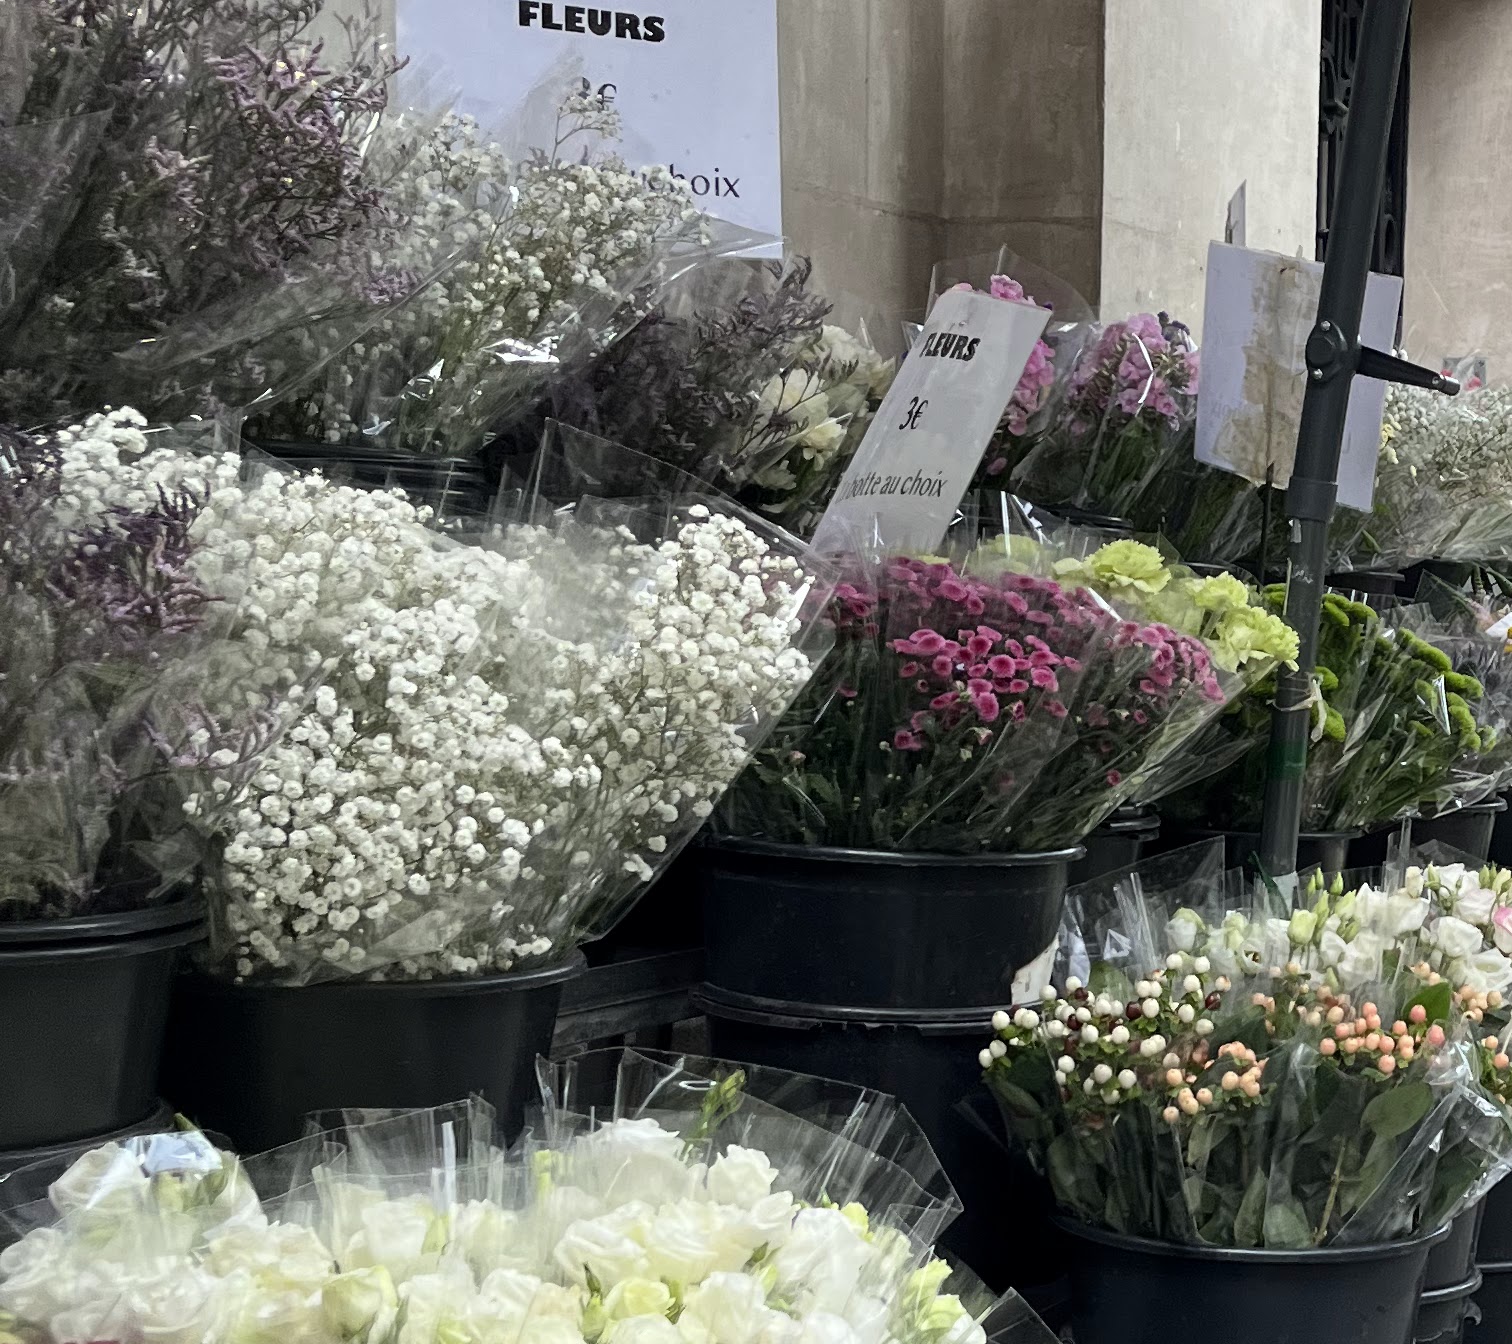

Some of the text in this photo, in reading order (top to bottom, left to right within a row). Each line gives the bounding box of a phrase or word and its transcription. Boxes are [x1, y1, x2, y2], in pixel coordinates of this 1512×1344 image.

[518, 0, 665, 42] FLEURS
[899, 396, 928, 429] 3€
[880, 475, 901, 495] au
[900, 468, 948, 498] choix
